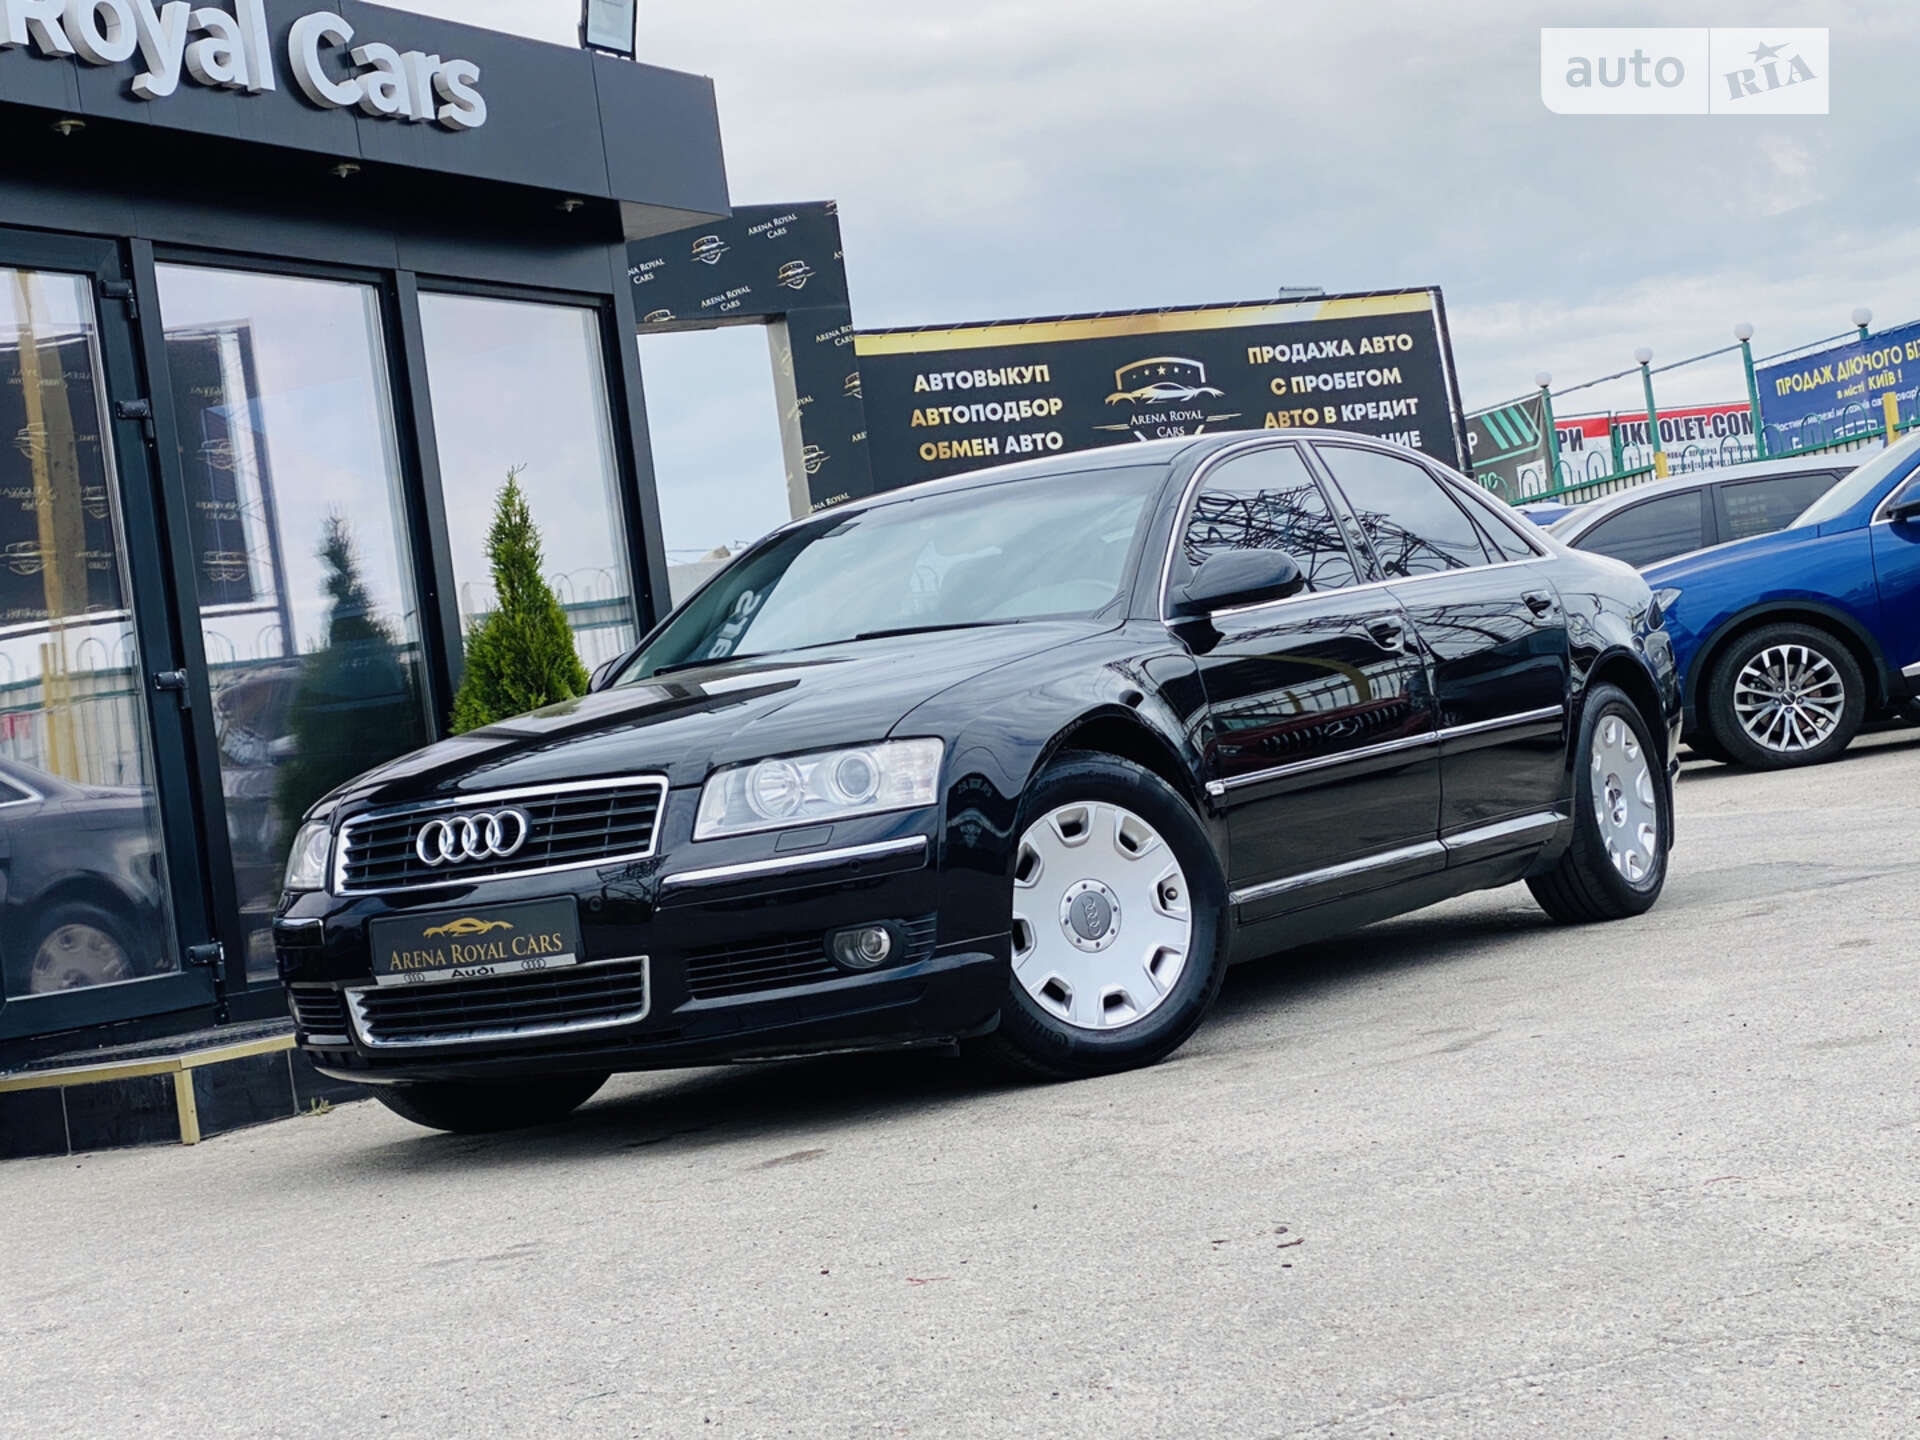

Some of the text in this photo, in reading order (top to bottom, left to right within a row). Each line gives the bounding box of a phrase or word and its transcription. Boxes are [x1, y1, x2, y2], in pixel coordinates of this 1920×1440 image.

[288, 11, 487, 128] Cars
[748, 212, 798, 235] ARENA ROYAL
[767, 226, 787, 239] CARS
[633, 272, 654, 284] CARS
[701, 285, 751, 309] ARENA ROYAL
[720, 299, 741, 312] CARS
[1247, 333, 1414, 365] ПРОДАЖА АВТО
[913, 364, 1051, 393] АВТОВЫКУП
[1270, 367, 1403, 396] С ПРОБЕГОМ
[1776, 364, 1835, 397] ПРОДАЖ
[1837, 346, 1903, 382] ДІЮЧОГО
[1867, 370, 1896, 390] КИЇВ
[910, 397, 1064, 428] АВТОПОДБОР
[1130, 409, 1205, 426] ARENA ROYAL
[1263, 397, 1419, 430] АВТО В КРЕДИТ
[1156, 426, 1185, 438] CARS
[919, 431, 1064, 462] ОБМЕН АВТО
[390, 932, 563, 971] ARENA ROYAL CARS
[451, 966, 496, 979] Audi
